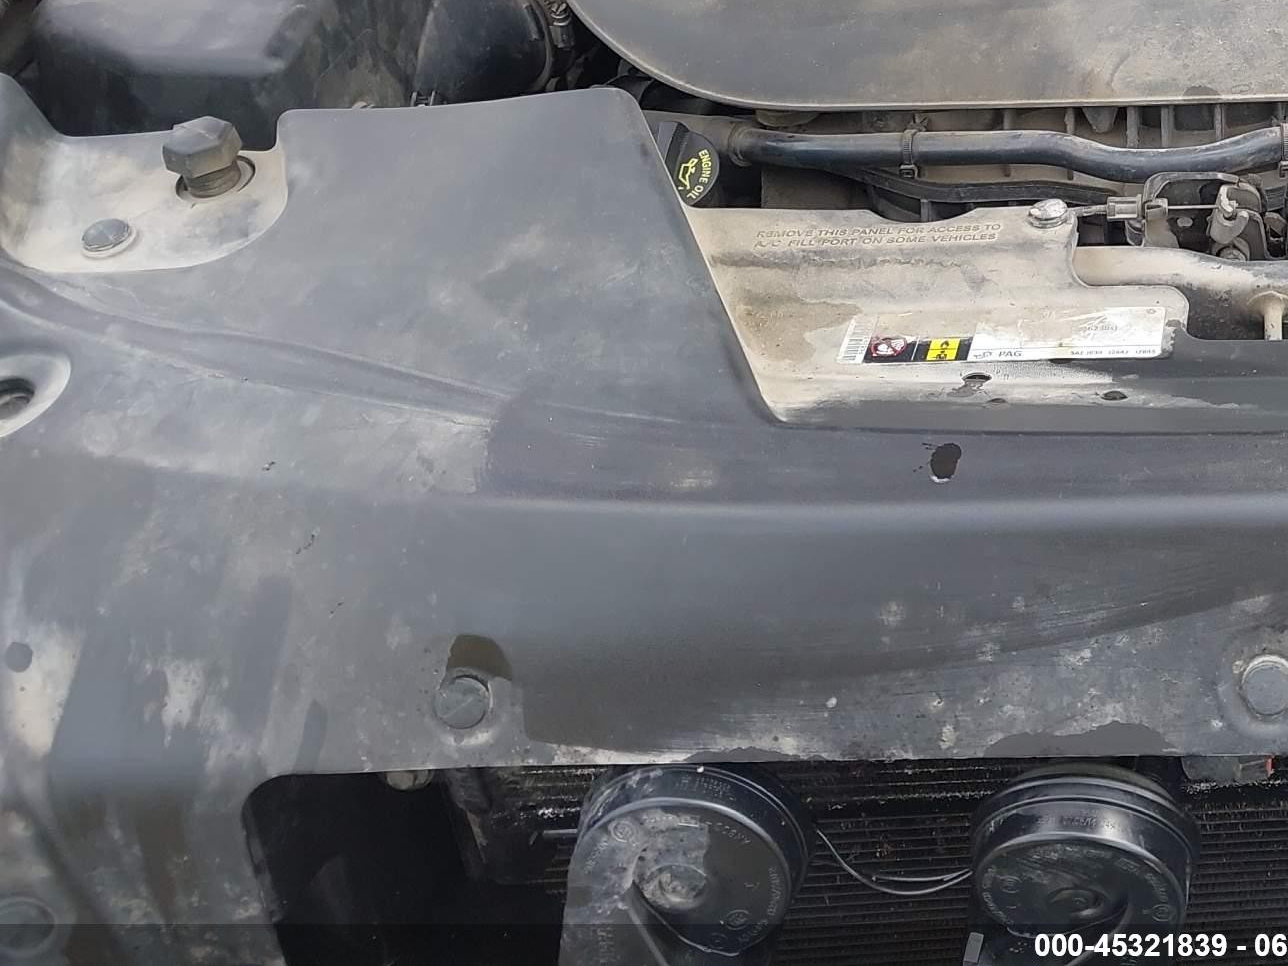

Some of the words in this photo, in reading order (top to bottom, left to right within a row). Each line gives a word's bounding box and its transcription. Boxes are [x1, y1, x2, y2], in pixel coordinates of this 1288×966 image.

[698, 148, 712, 184] ENGINE
[686, 184, 704, 199] OIL
[756, 229, 816, 238] REMOVE
[818, 228, 848, 237] THIS
[850, 227, 894, 237] PANEL
[897, 227, 925, 235] FOR
[927, 224, 981, 234] ACCESS
[984, 223, 1002, 231] TO
[787, 238, 816, 247] FILL
[820, 237, 858, 246] PORT
[862, 236, 883, 245] ON
[886, 235, 927, 244] SOME
[931, 233, 998, 243] VEHICLES
[998, 350, 1023, 358] PAG
